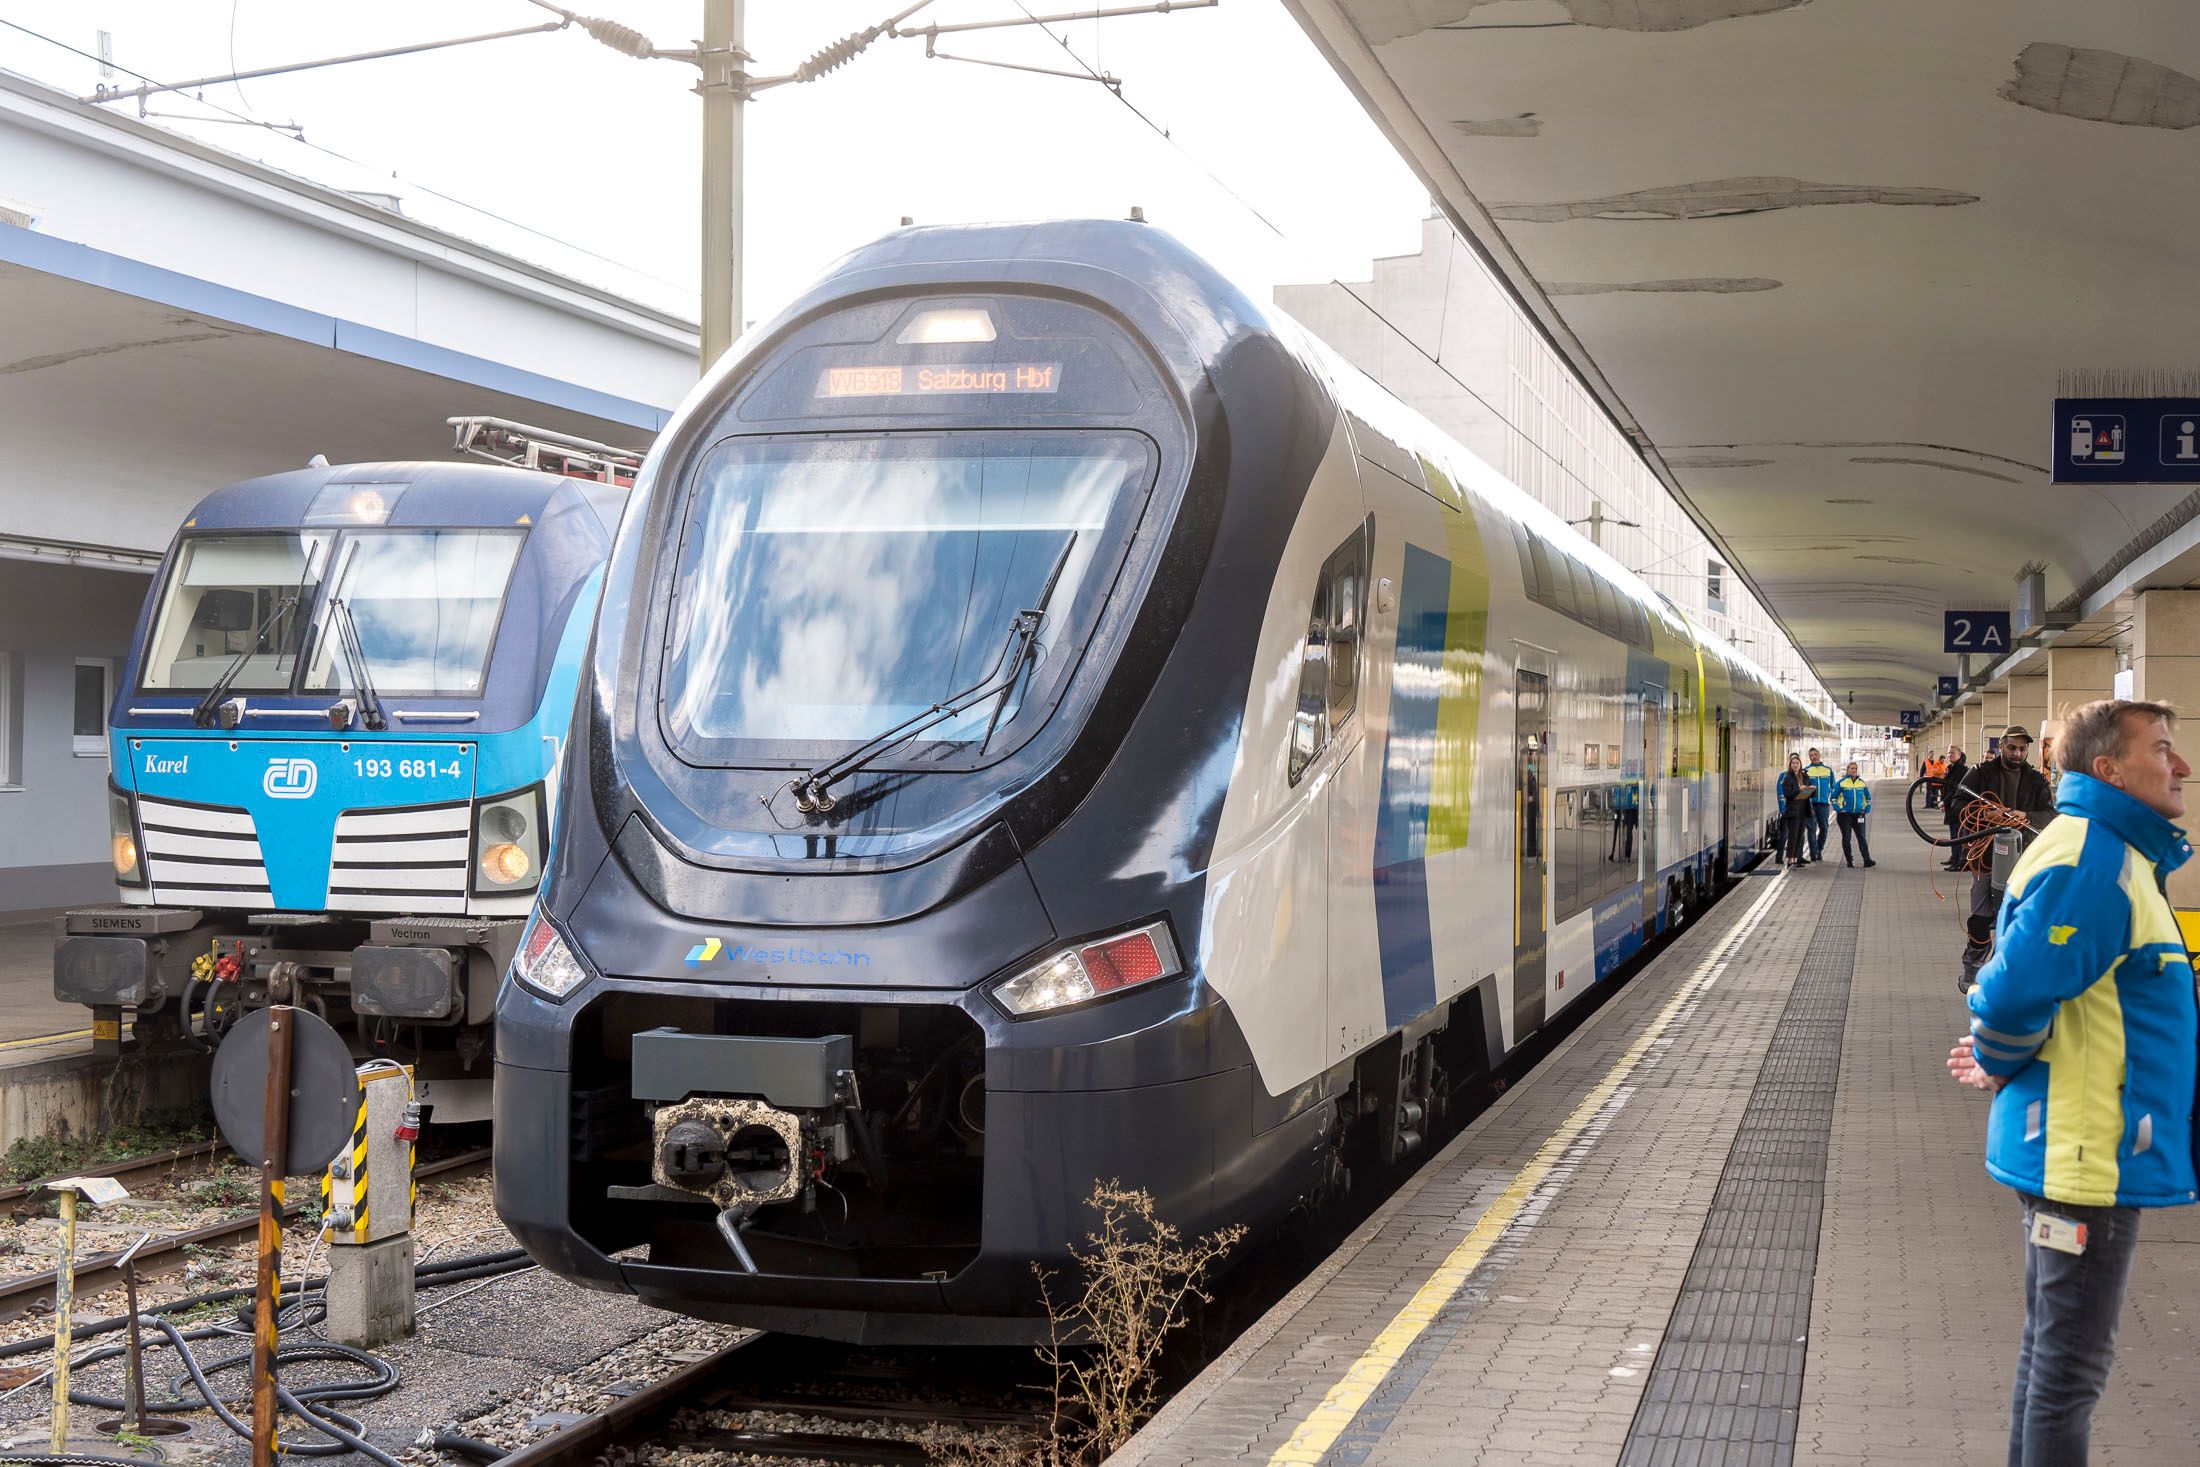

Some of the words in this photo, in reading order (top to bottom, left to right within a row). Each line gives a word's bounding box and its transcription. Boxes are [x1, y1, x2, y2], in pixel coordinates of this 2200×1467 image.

[917, 369, 1006, 392] Salzburg
[1016, 366, 1053, 388] Hbf
[1953, 619, 1972, 646] 2
[1982, 625, 2002, 646] A
[1903, 713, 1910, 722] 2
[144, 754, 190, 775] Karel
[353, 759, 393, 778] 193
[399, 760, 462, 778] 681-4
[92, 918, 142, 929] SIEMENS
[391, 927, 431, 940] Vectron
[725, 944, 872, 967] Westbahn
